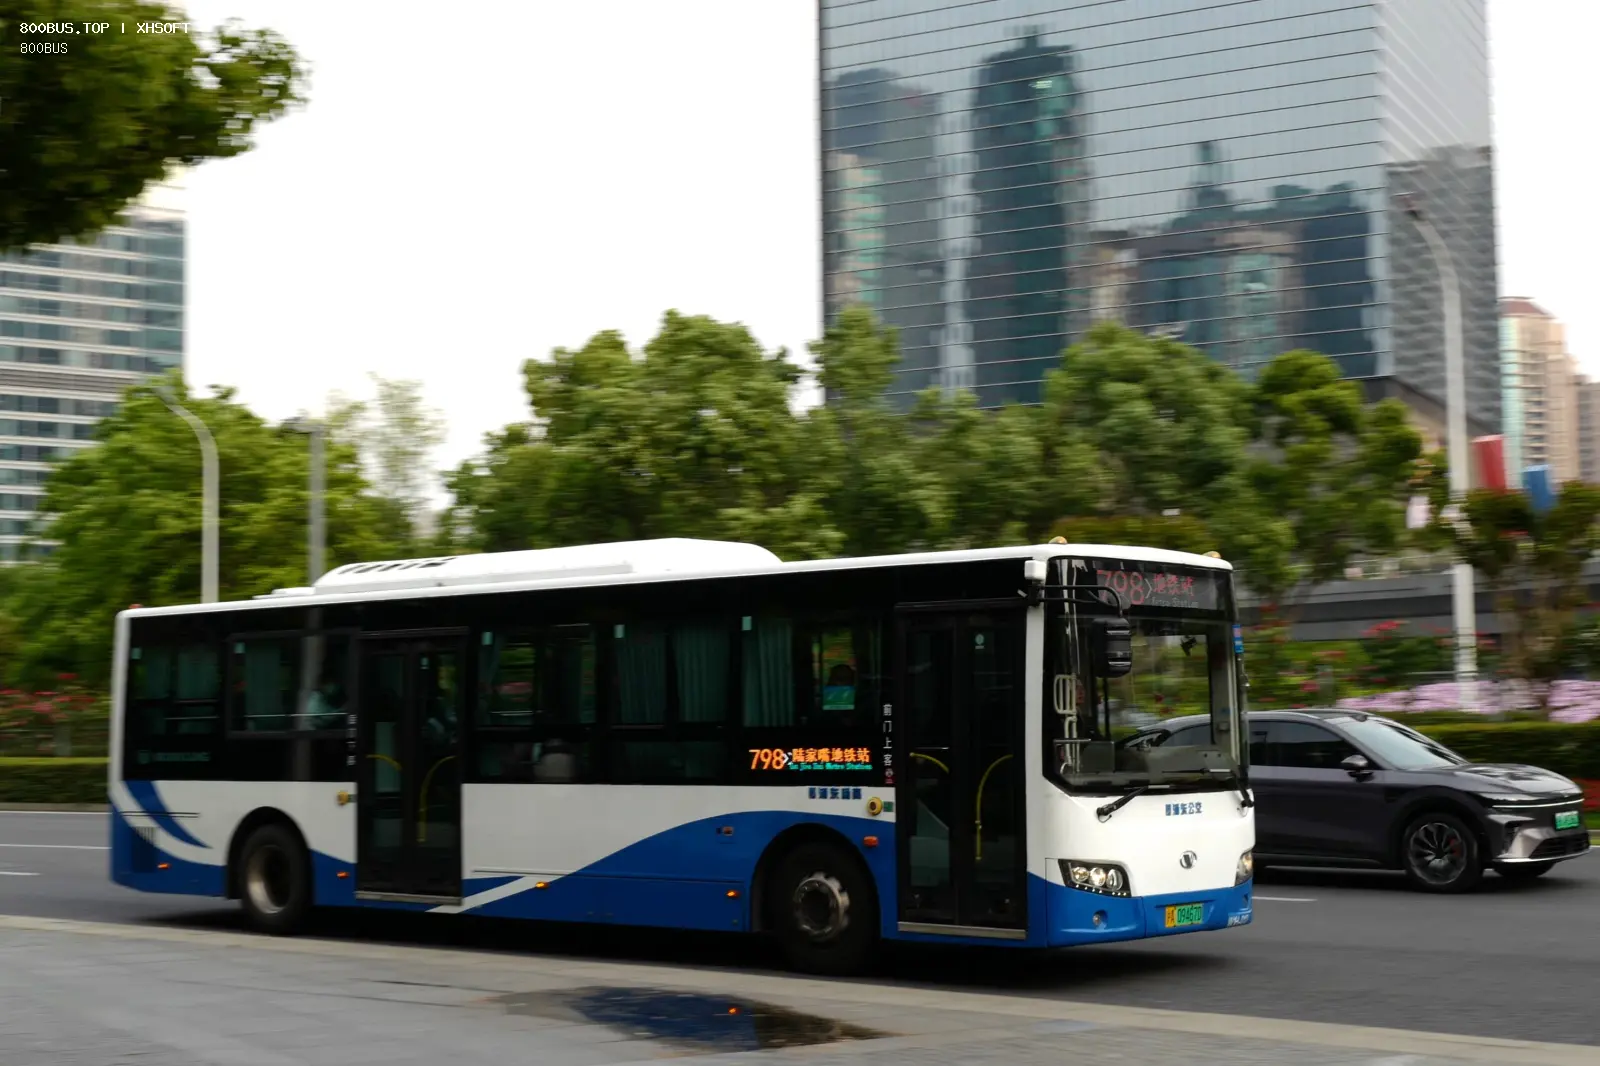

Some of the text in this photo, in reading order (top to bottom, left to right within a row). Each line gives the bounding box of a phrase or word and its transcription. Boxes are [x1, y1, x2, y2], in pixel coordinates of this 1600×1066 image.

[749, 749, 785, 770] 798
[792, 748, 870, 763] 陆家嘴地铁站
